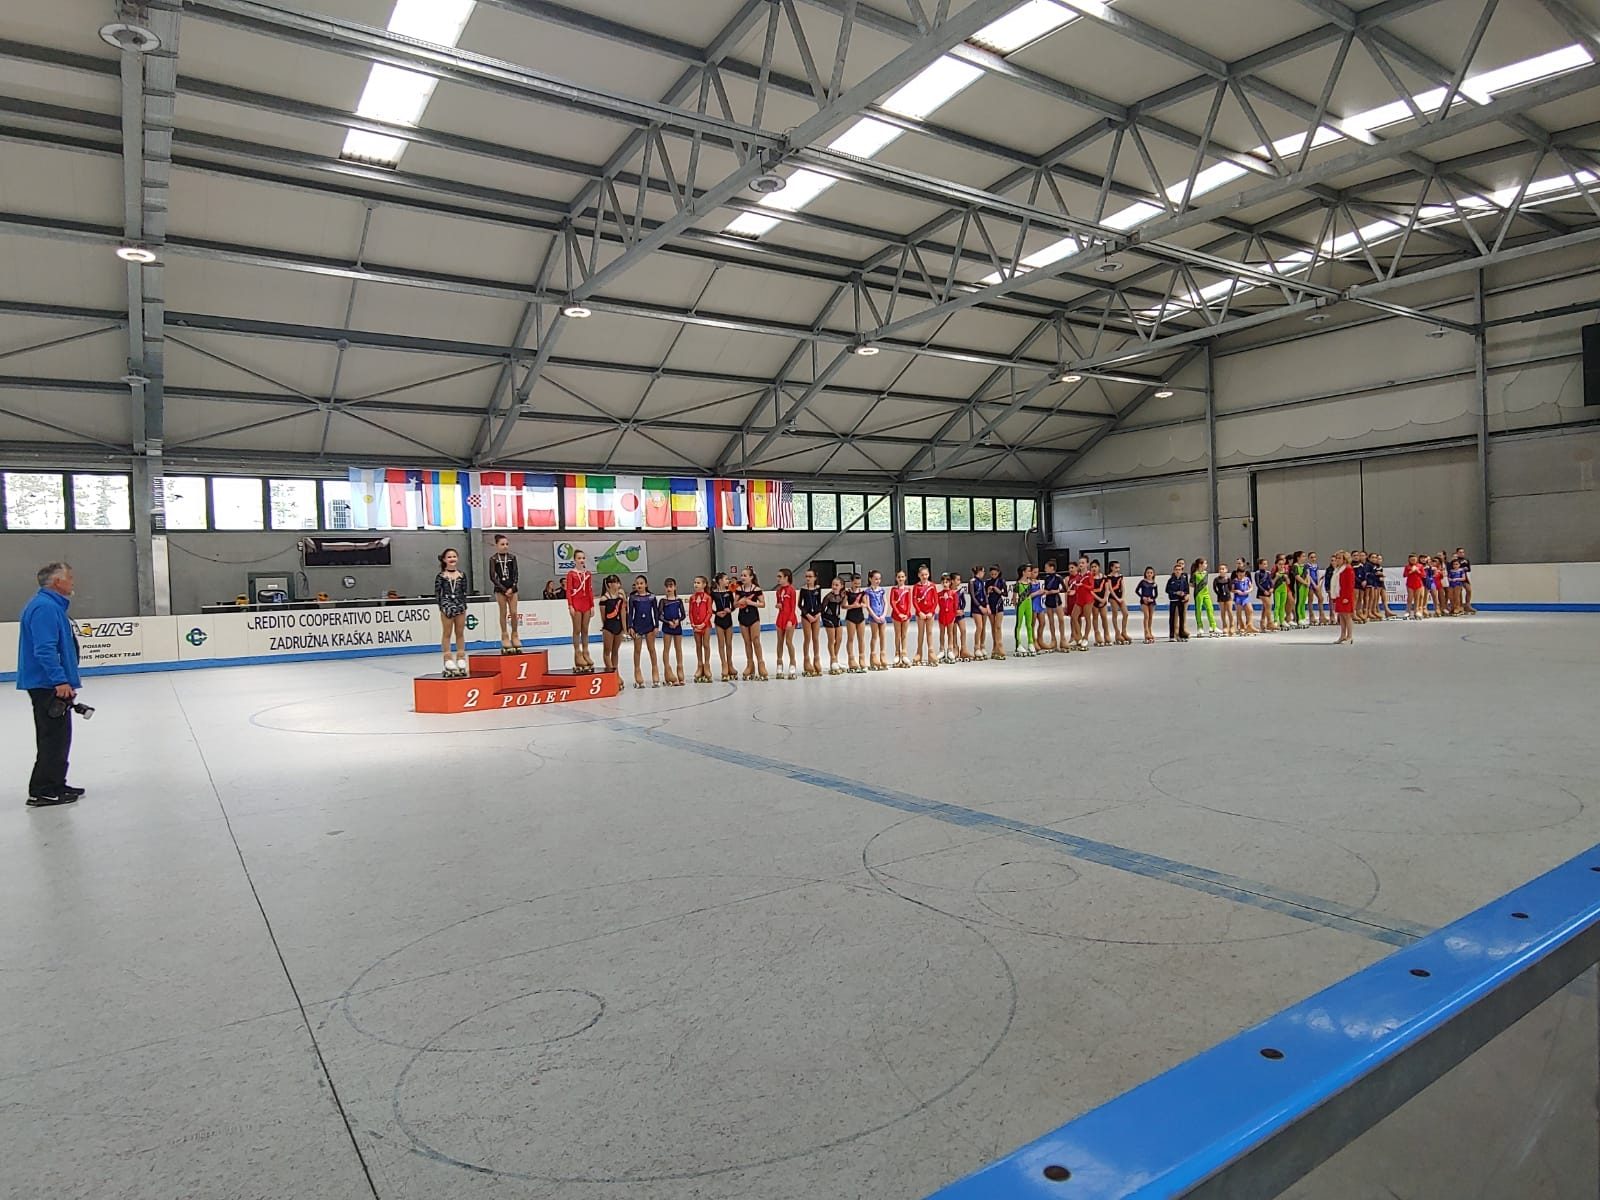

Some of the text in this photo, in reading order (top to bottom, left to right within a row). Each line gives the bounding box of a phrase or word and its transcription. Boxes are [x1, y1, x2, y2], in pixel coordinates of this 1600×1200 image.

[299, 611, 372, 627] COOPERATIVO
[375, 610, 394, 624] DEL
[269, 629, 412, 650] ZADRUŽNA KRAŠKA BANKA
[516, 662, 528, 680] 1
[589, 677, 602, 695] 3
[463, 688, 480, 708] 2
[502, 689, 570, 707] POLET
